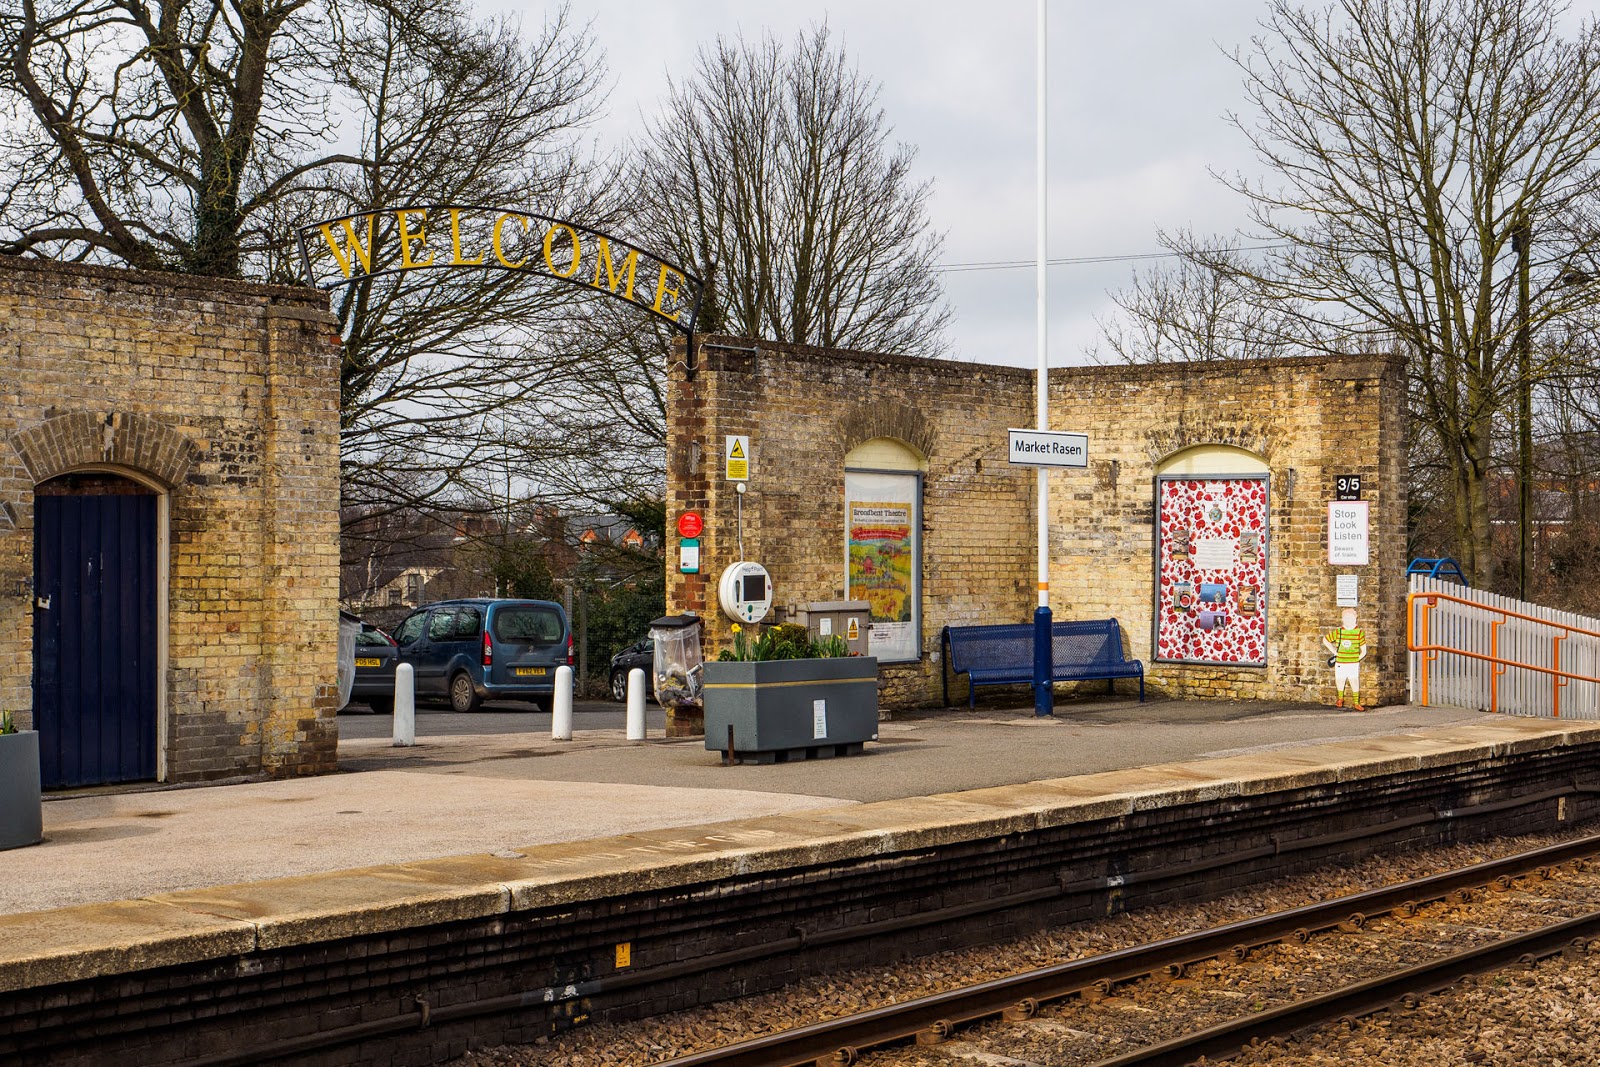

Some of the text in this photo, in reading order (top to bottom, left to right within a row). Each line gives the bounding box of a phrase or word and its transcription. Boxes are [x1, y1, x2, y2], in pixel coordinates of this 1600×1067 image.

[319, 208, 685, 322] WELCOME
[1015, 440, 1082, 455] Market Rasen
[1338, 478, 1360, 493] 3/5
[884, 509, 907, 517] Theatre
[1334, 509, 1356, 519] Stop
[1334, 521, 1357, 529] Look
[1334, 532, 1362, 540] Listen
